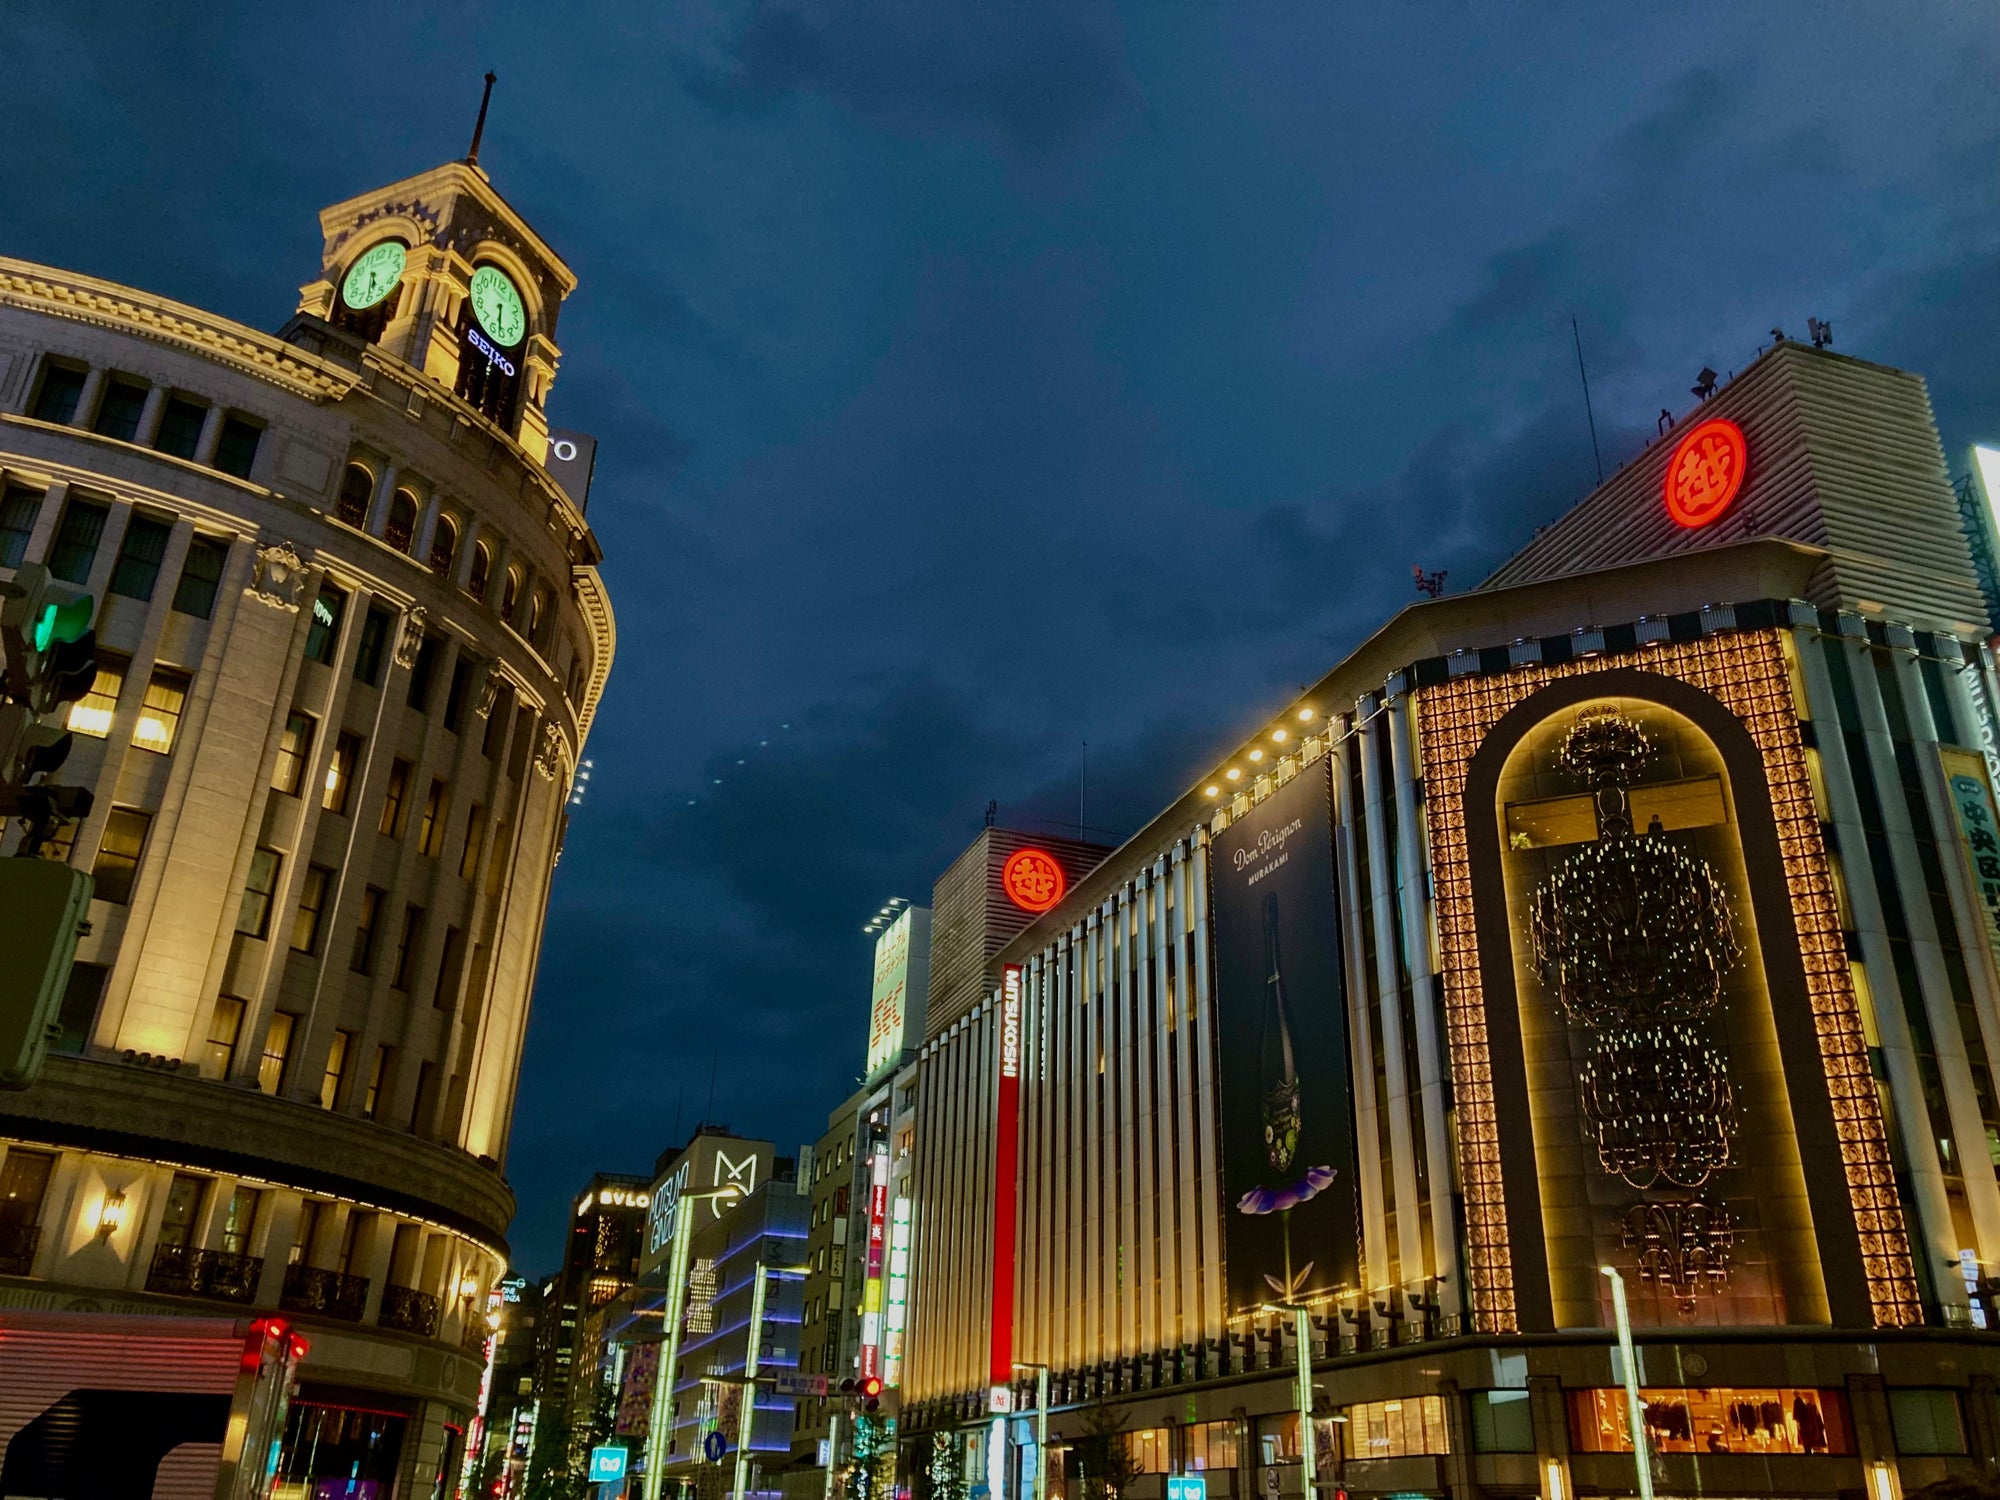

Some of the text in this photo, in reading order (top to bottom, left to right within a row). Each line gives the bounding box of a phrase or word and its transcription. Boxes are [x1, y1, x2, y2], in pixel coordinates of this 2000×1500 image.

[467, 329, 516, 378] SEIKO
[1233, 848, 1259, 872] Dom
[1248, 852, 1289, 886] MURAKAMI
[1003, 970, 1019, 1078] MITSUKOSHI
